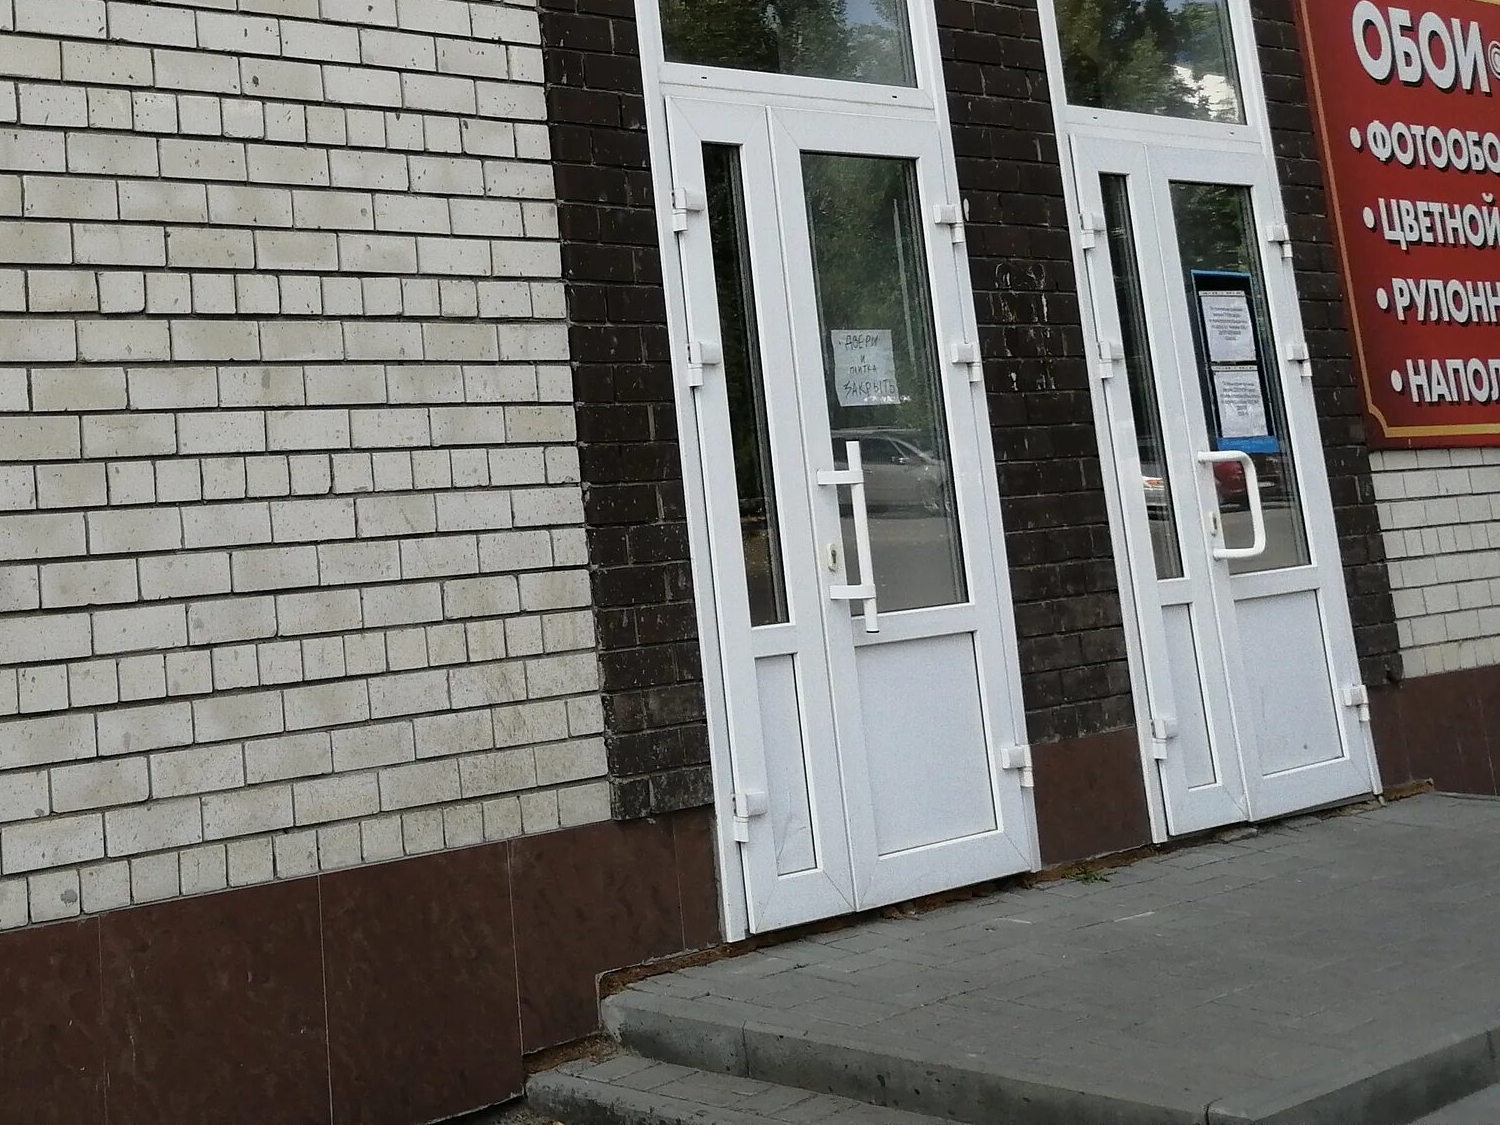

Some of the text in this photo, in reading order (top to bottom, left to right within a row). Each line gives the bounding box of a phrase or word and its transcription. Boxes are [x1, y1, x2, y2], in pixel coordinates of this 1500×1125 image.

[1352, 0, 1491, 94] ОБОИ
[1367, 120, 1500, 174] ФОТООБО
[1378, 192, 1500, 251] ЦВЕТНОЙ
[845, 334, 879, 351] ДВЕРИ
